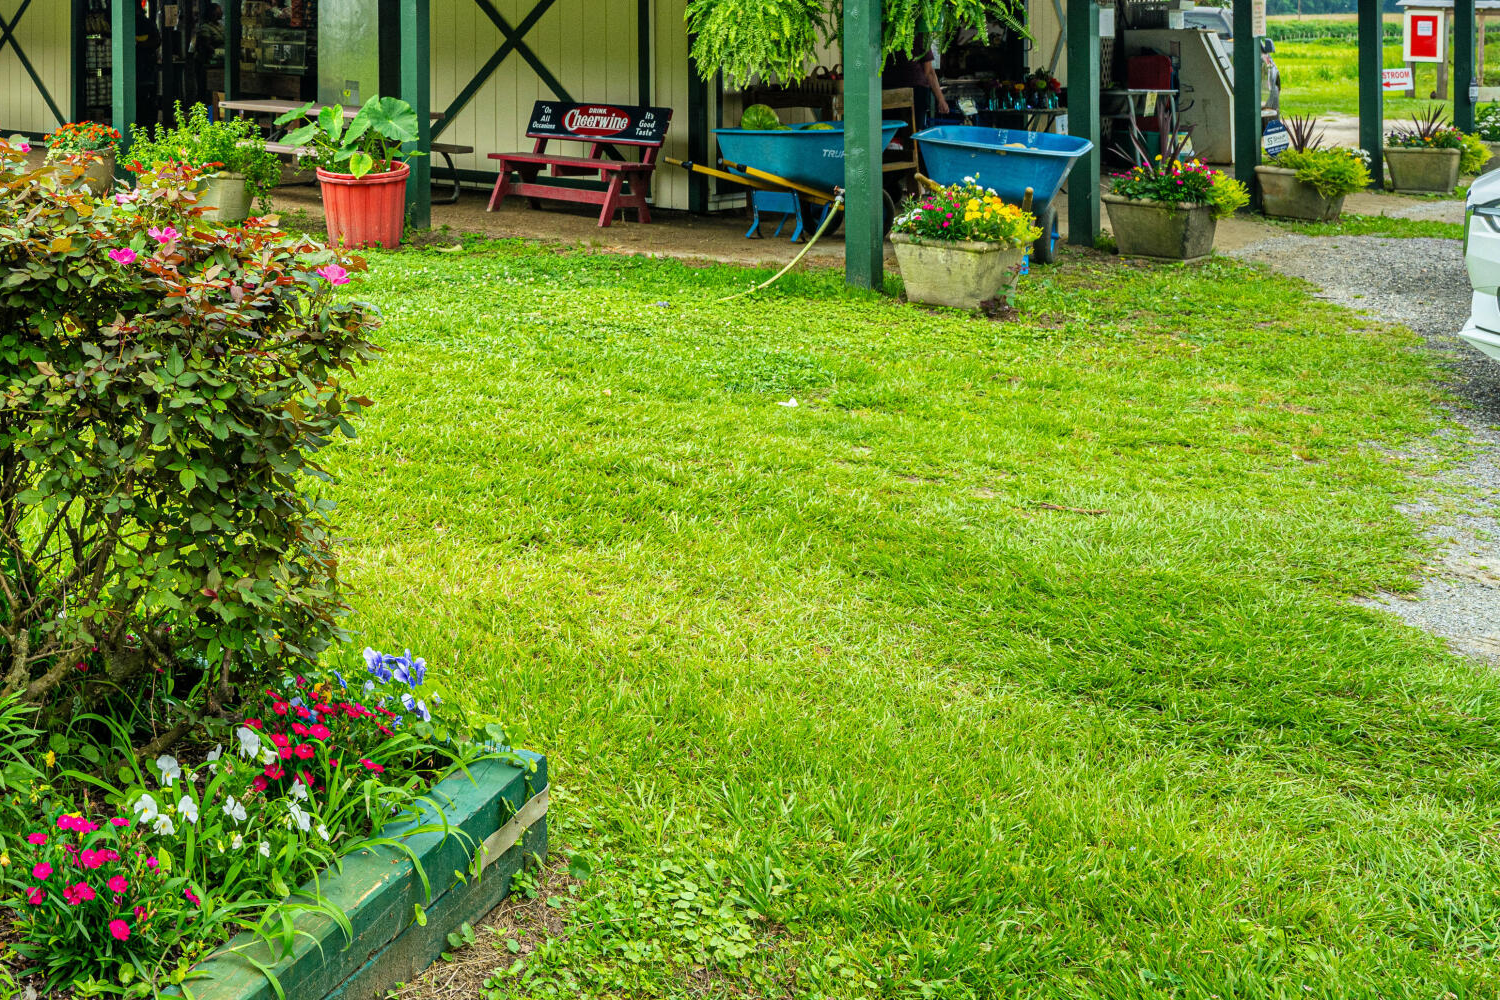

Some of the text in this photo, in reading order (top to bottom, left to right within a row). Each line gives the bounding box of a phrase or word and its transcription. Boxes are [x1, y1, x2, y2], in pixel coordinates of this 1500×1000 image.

[1381, 71, 1410, 80] STROOM
[588, 107, 607, 115] DRINK
[540, 114, 551, 122] All
[564, 109, 629, 131] Cheerwine
[638, 119, 656, 129] Good
